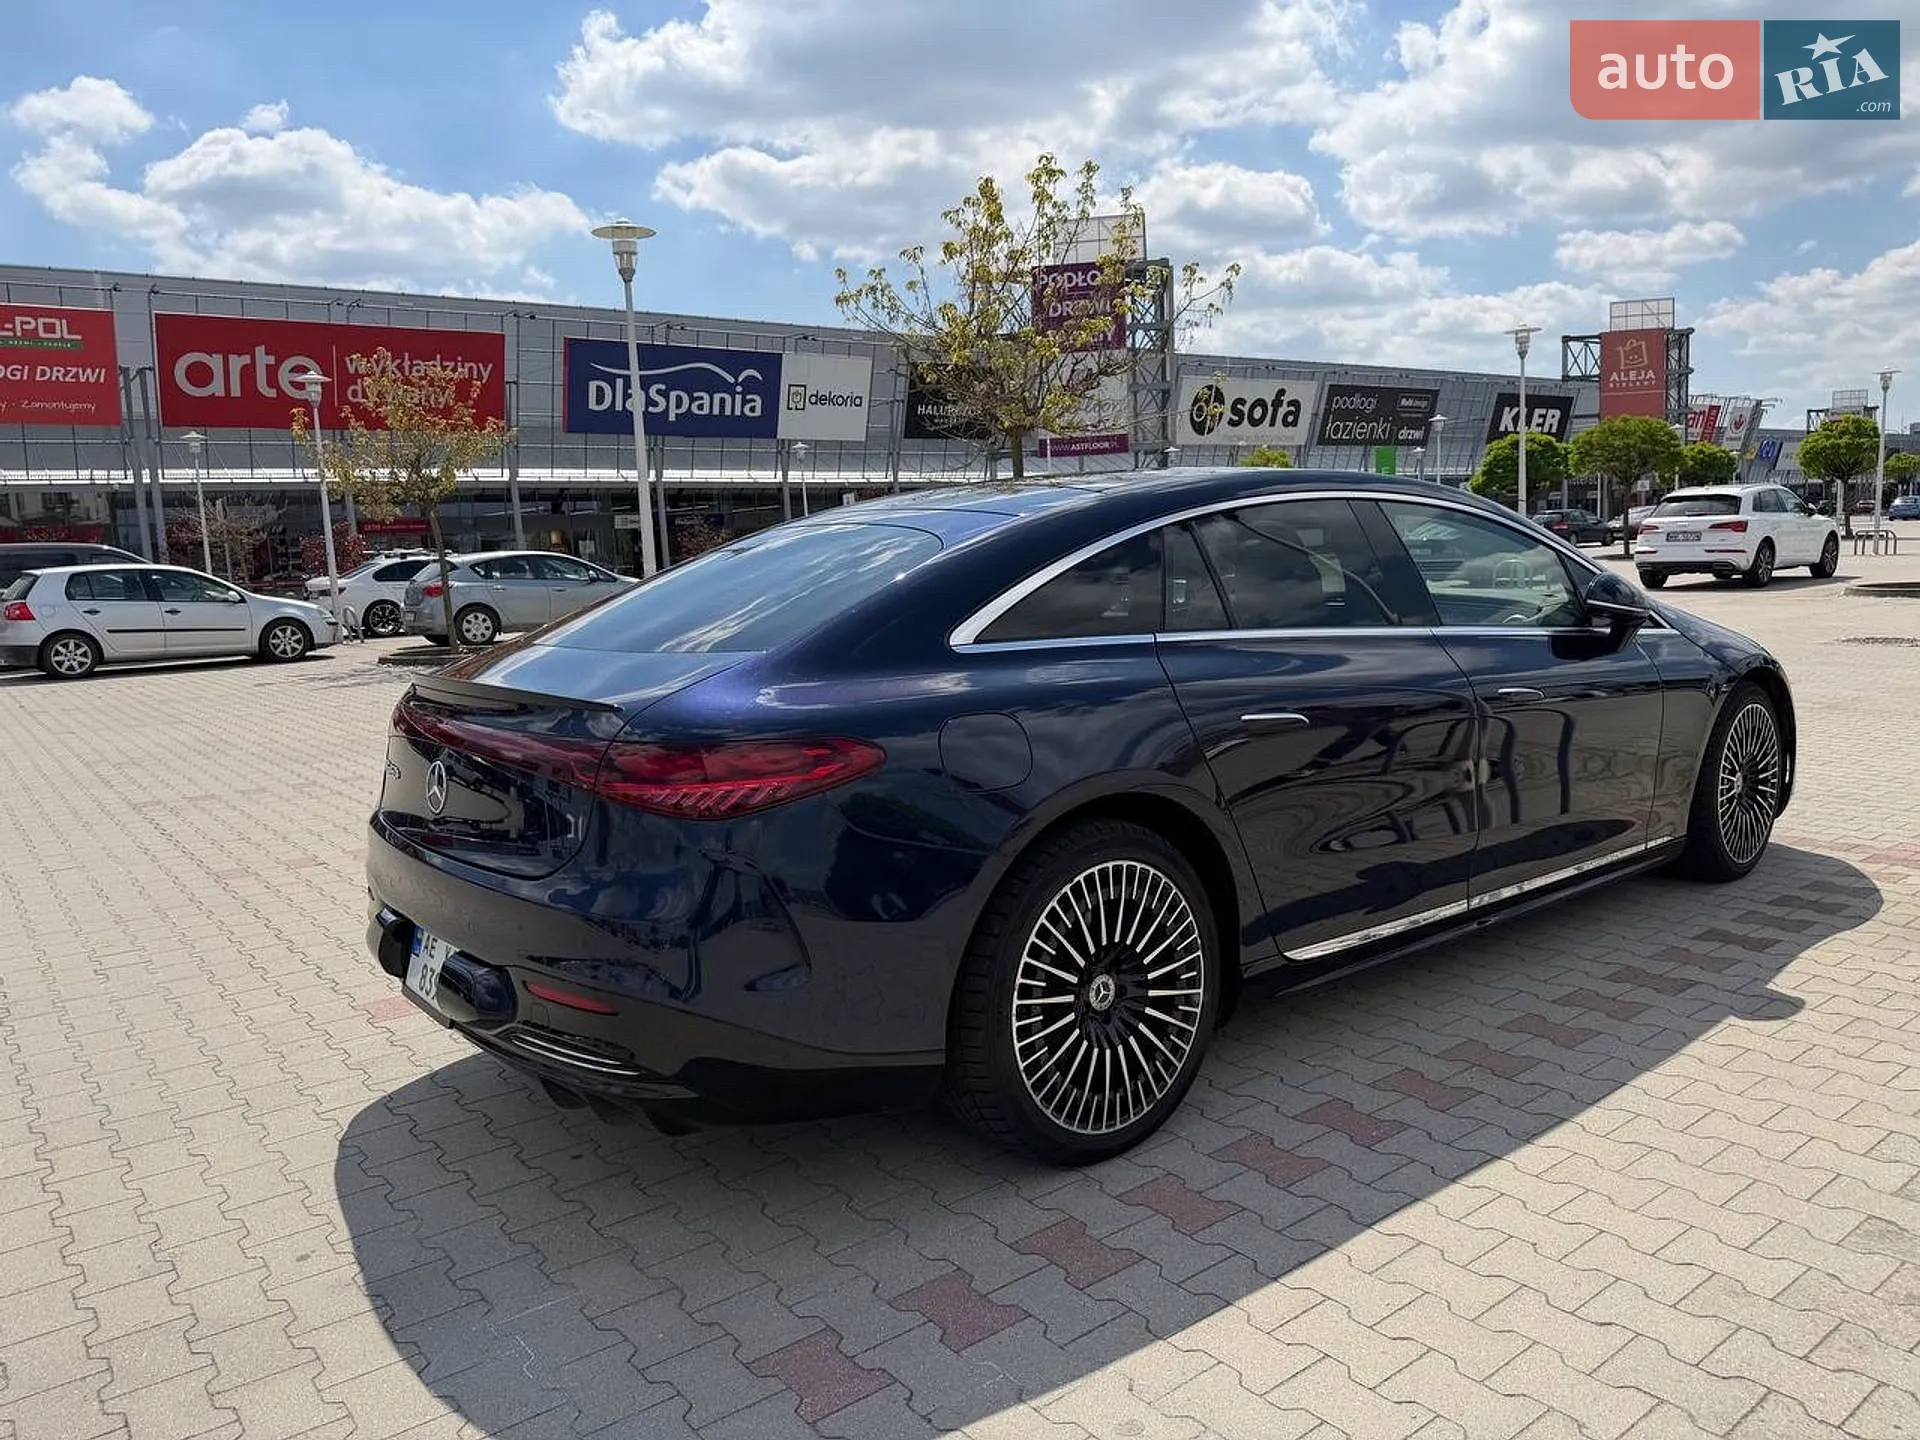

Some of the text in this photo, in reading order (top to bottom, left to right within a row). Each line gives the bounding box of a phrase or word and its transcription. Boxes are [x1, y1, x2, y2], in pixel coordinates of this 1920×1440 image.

[35, 365, 106, 383] DRZWI
[174, 344, 323, 401] arte
[1609, 369, 1656, 382] ALEJA
[588, 377, 762, 421] DlaSpania
[808, 389, 863, 408] dekoria
[1227, 387, 1301, 428] sofa
[1331, 394, 1379, 413] podłogi
[1325, 414, 1393, 440] łazienki
[1398, 425, 1435, 440] drzwi
